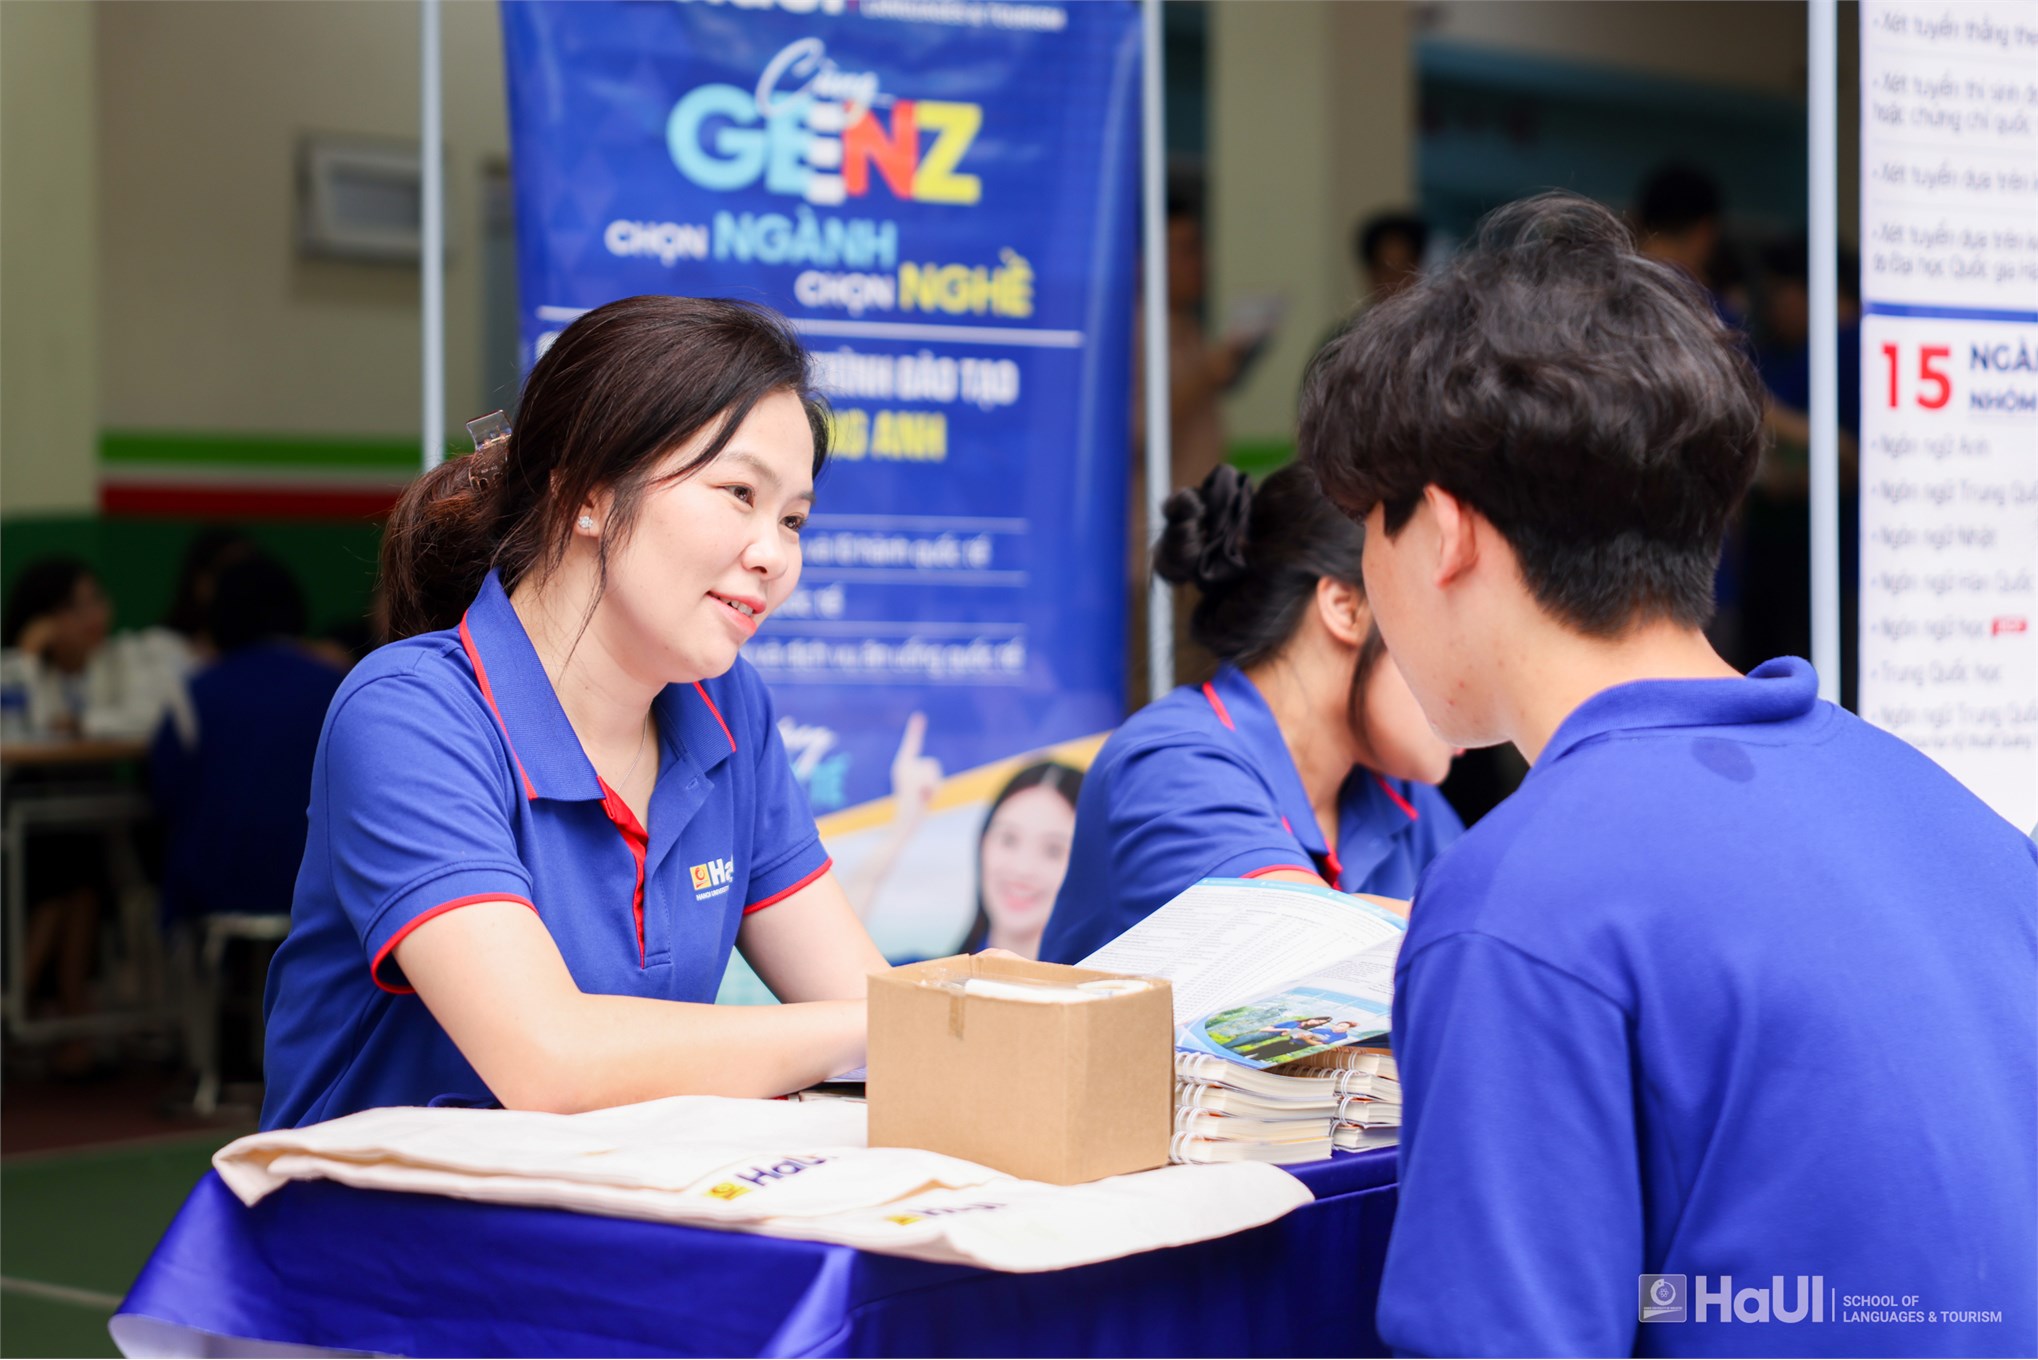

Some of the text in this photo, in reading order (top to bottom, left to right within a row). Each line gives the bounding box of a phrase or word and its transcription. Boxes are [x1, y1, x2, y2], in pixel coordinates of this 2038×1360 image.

[604, 203, 899, 269] CHỌN NGÀNH
[793, 247, 1036, 319] CHỌN NGHỀ
[960, 357, 1021, 412] TẠO
[1881, 336, 2038, 411] 15 NGÀ
[871, 409, 948, 464] ANH
[707, 855, 734, 886] Ha
